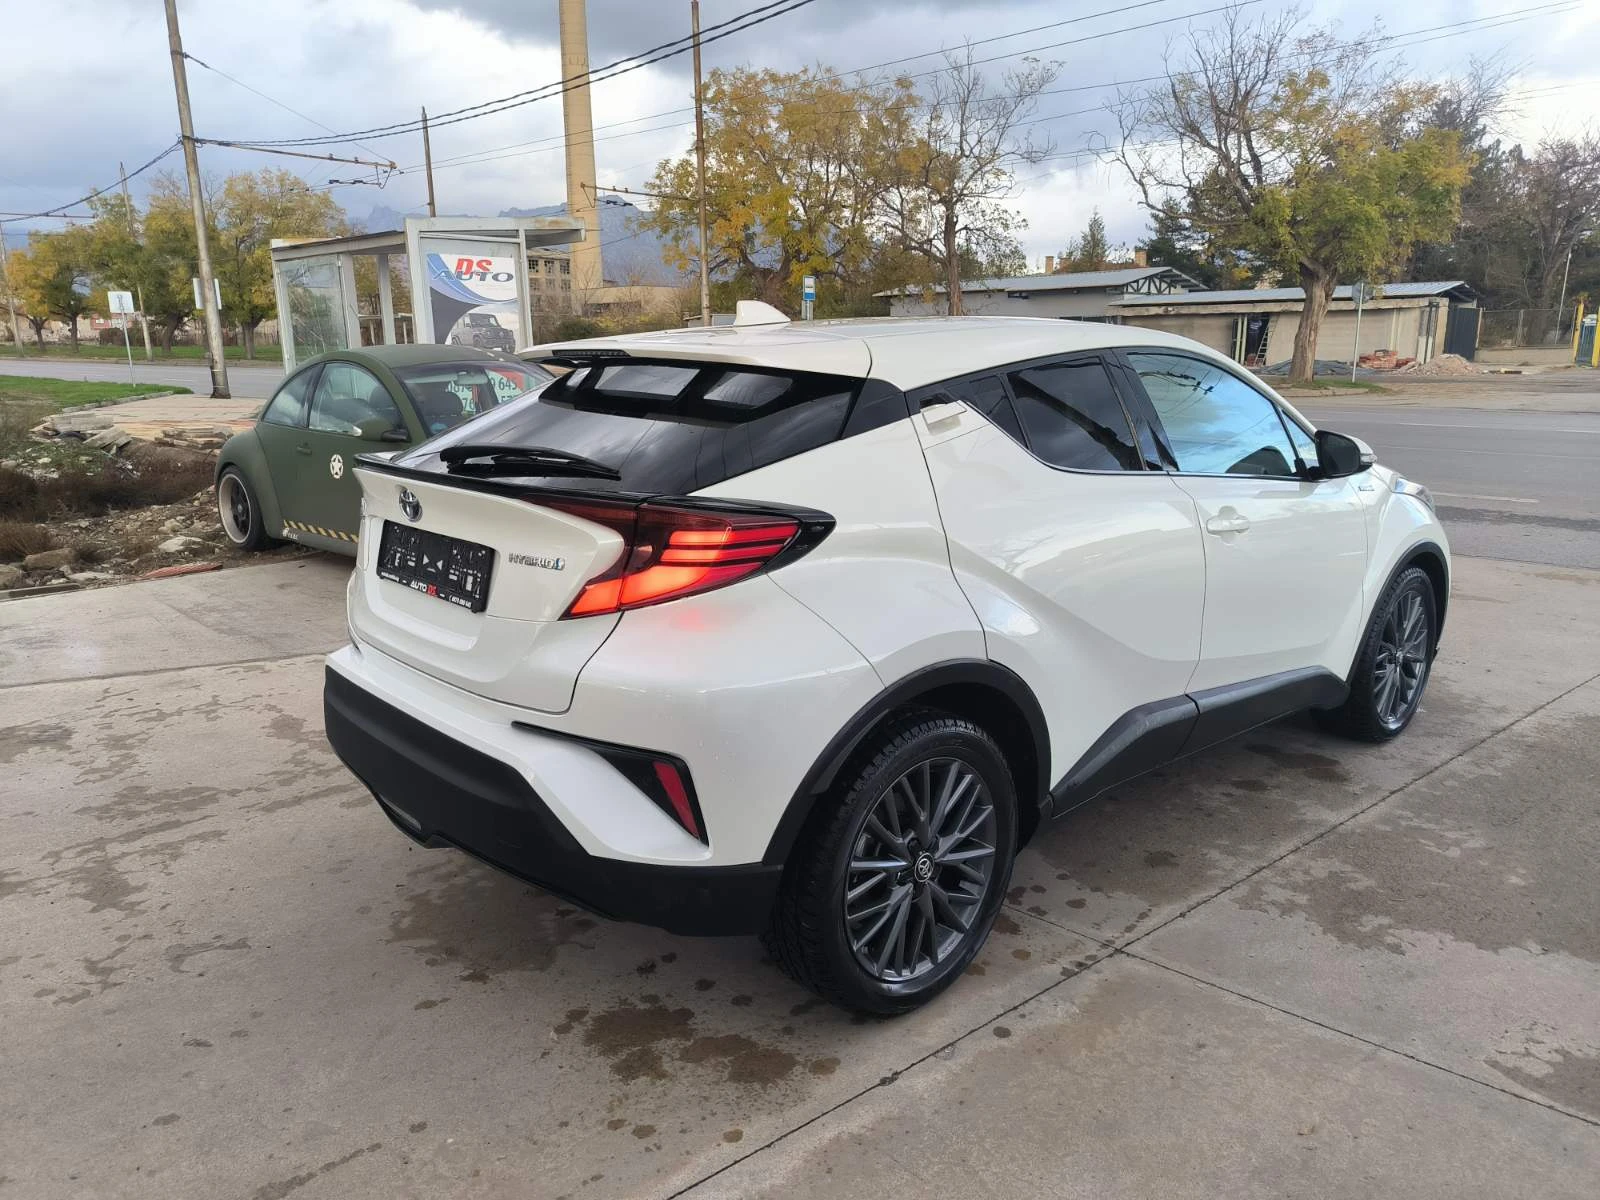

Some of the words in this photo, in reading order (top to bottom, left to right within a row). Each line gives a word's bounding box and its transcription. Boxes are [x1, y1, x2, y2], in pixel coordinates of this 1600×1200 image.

[455, 257, 493, 275] DS
[433, 271, 514, 282] AUTO
[410, 580, 427, 592] AUTO
